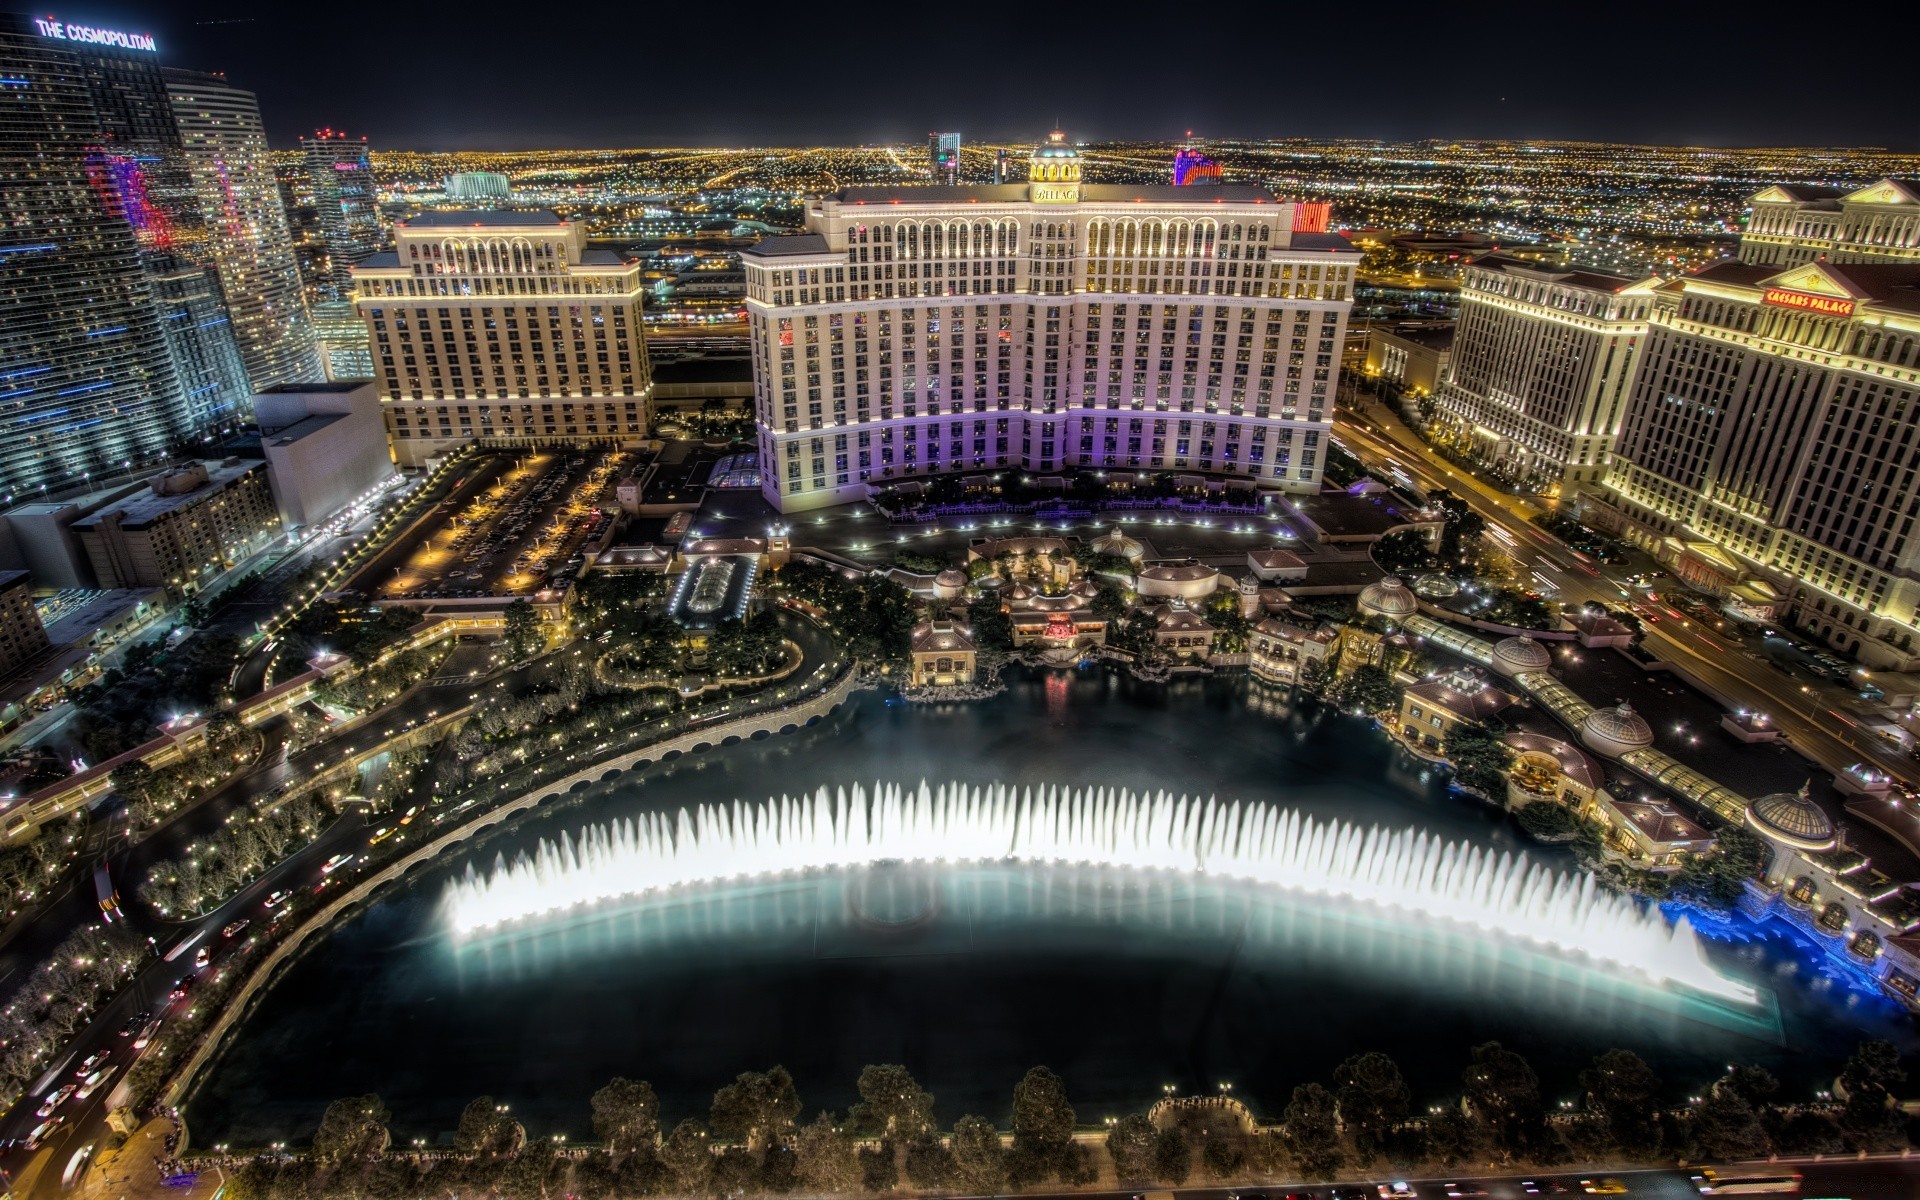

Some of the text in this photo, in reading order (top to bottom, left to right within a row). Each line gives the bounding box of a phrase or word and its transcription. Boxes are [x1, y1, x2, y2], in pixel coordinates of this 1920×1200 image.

[35, 19, 157, 52] THE COSMOPOLITAN
[1766, 291, 1853, 315] CAESARS PALACE
